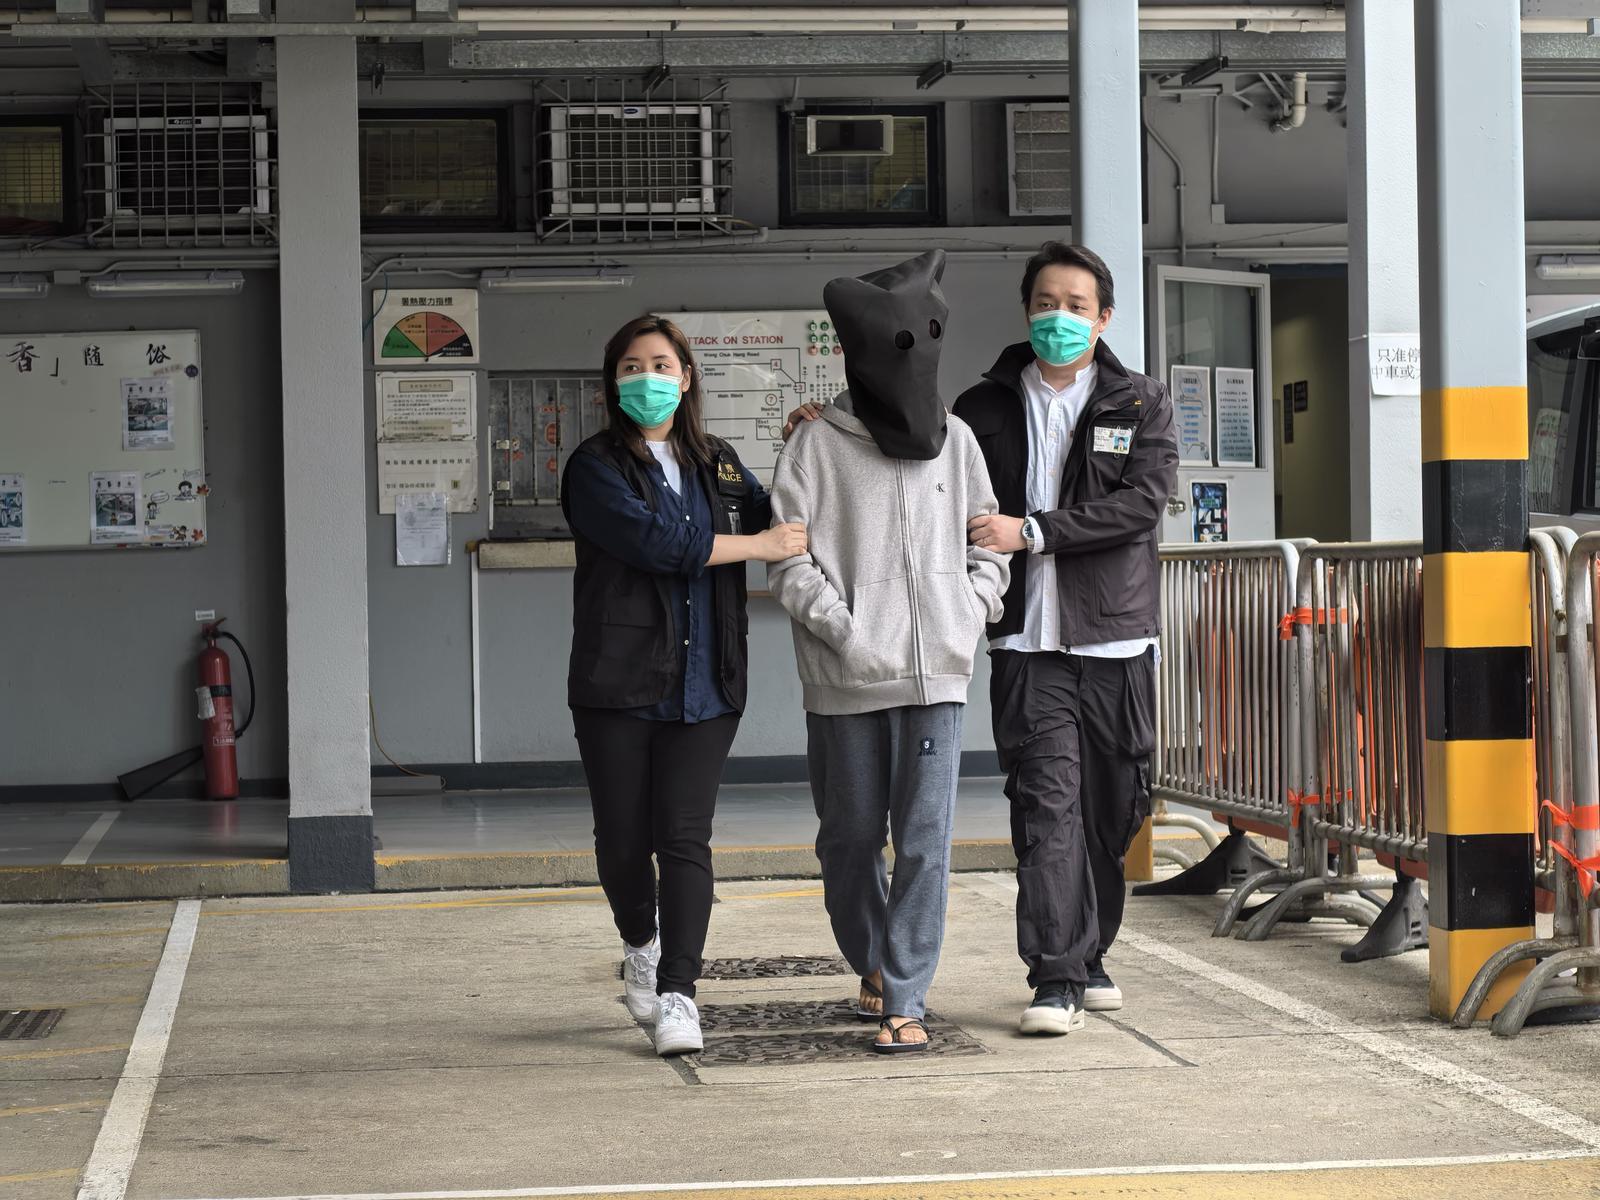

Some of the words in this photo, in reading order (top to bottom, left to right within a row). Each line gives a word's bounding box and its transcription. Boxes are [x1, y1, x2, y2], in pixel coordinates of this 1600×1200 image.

[687, 336, 719, 345] TTACK
[723, 336, 738, 345] ON
[742, 335, 784, 344] STATION
